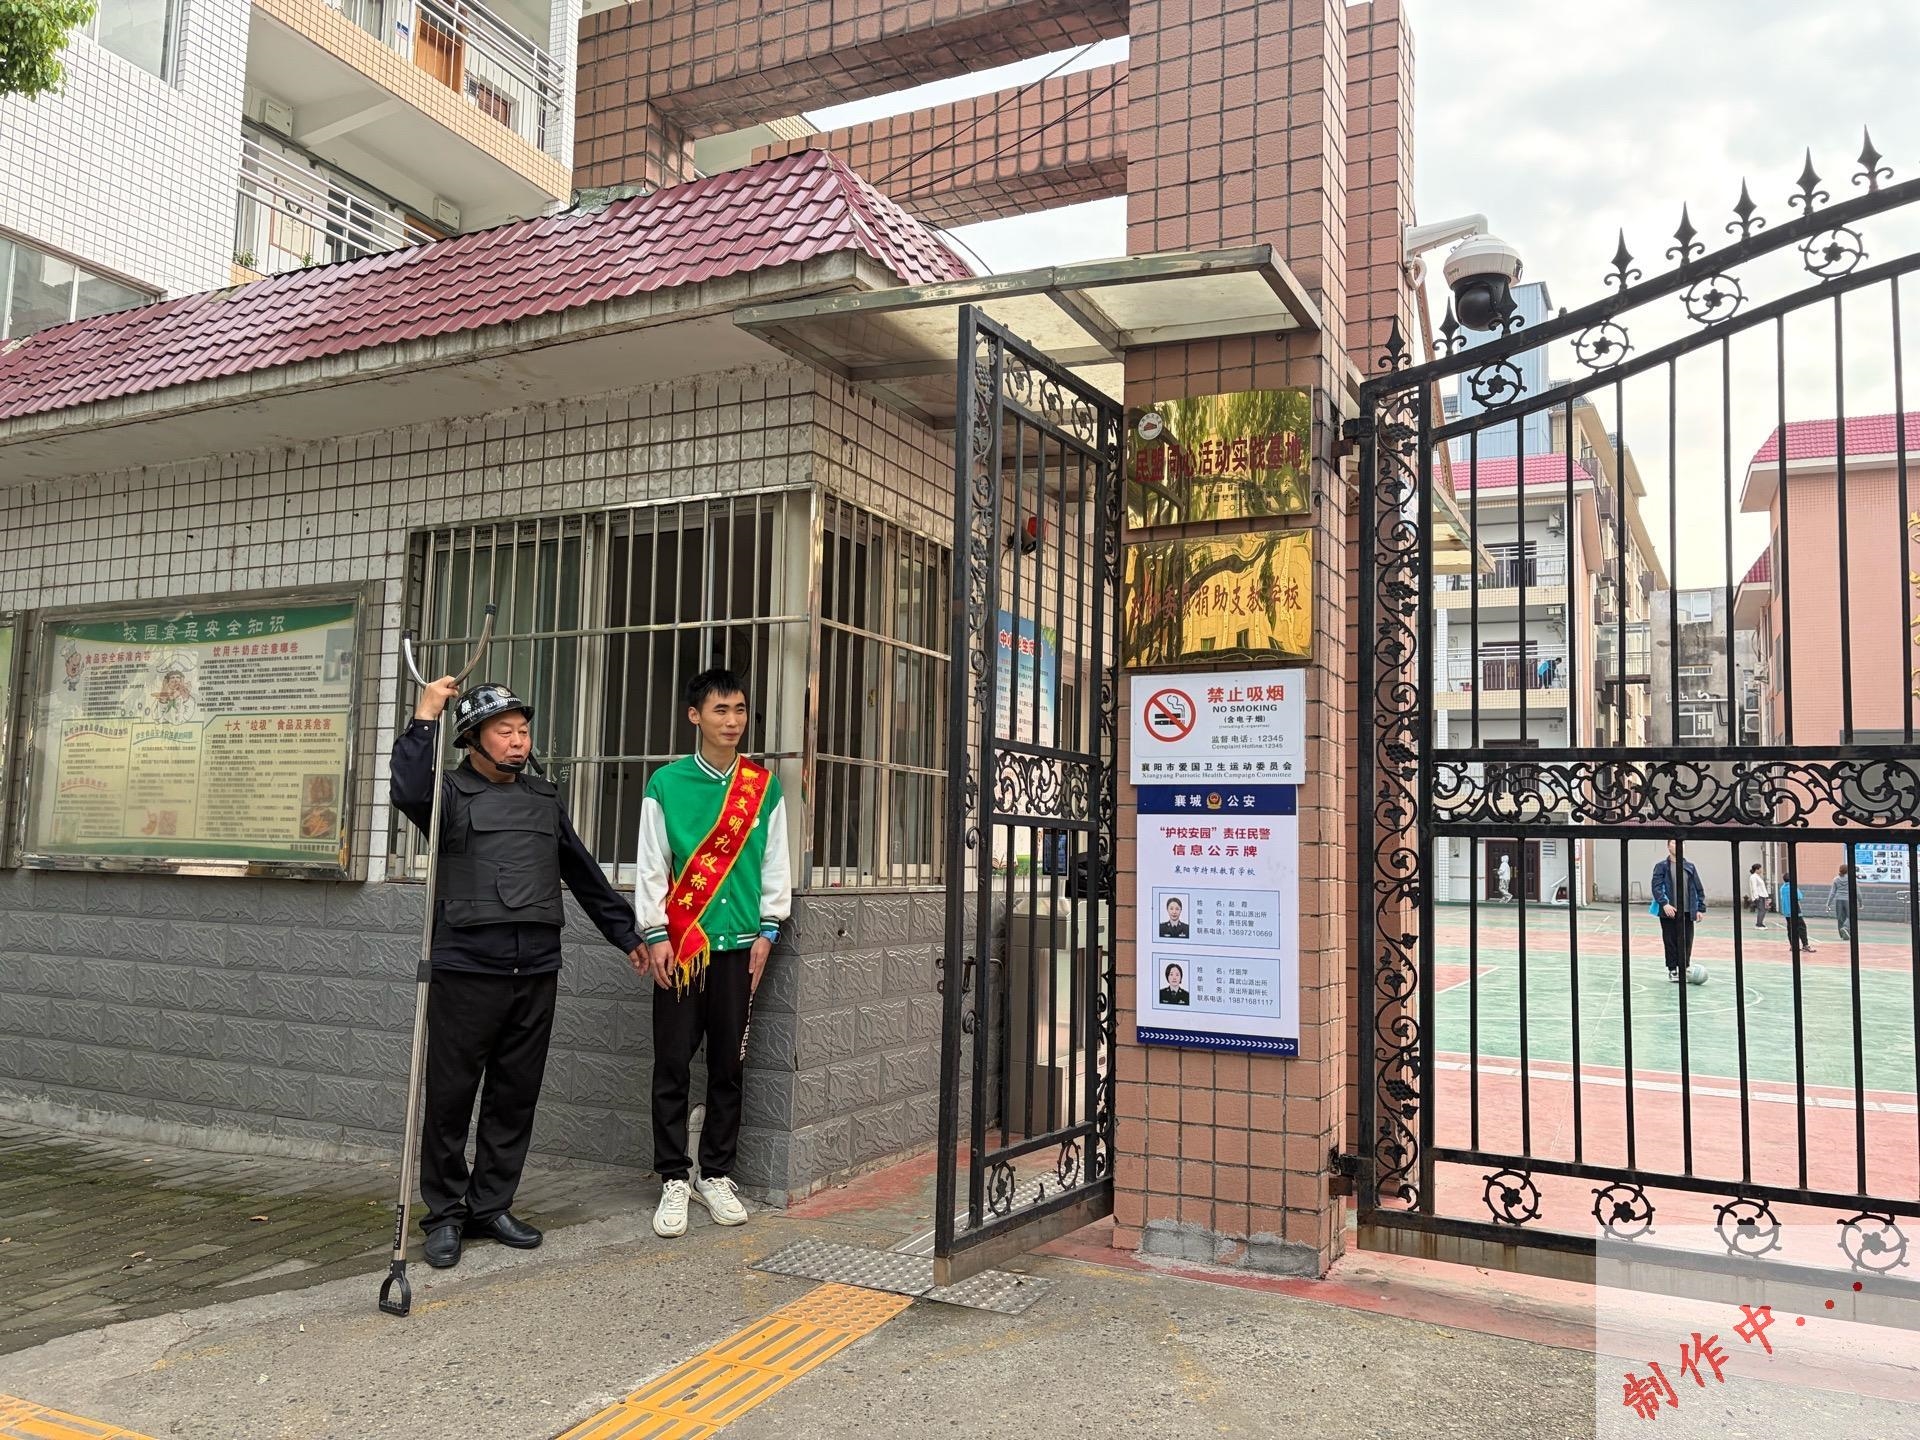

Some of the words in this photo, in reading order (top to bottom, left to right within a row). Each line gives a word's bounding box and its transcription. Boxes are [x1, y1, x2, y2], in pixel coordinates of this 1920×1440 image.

[123, 615, 286, 642] 校园食品安全知识
[213, 642, 299, 657] 饮用牛奶应注意哪些
[85, 651, 151, 665] 食品安全标准内容
[1207, 685, 1284, 703] 禁止吸烟
[1230, 704, 1277, 712] SMOKING
[1141, 761, 1292, 772] 襄阳市爱国卫生运动委员会
[1174, 795, 1202, 807] 襄城
[1227, 795, 1256, 807] 公安
[1173, 844, 1258, 858] 信息公示牌
[1174, 865, 1256, 876] 襄阳市特殊教育学校
